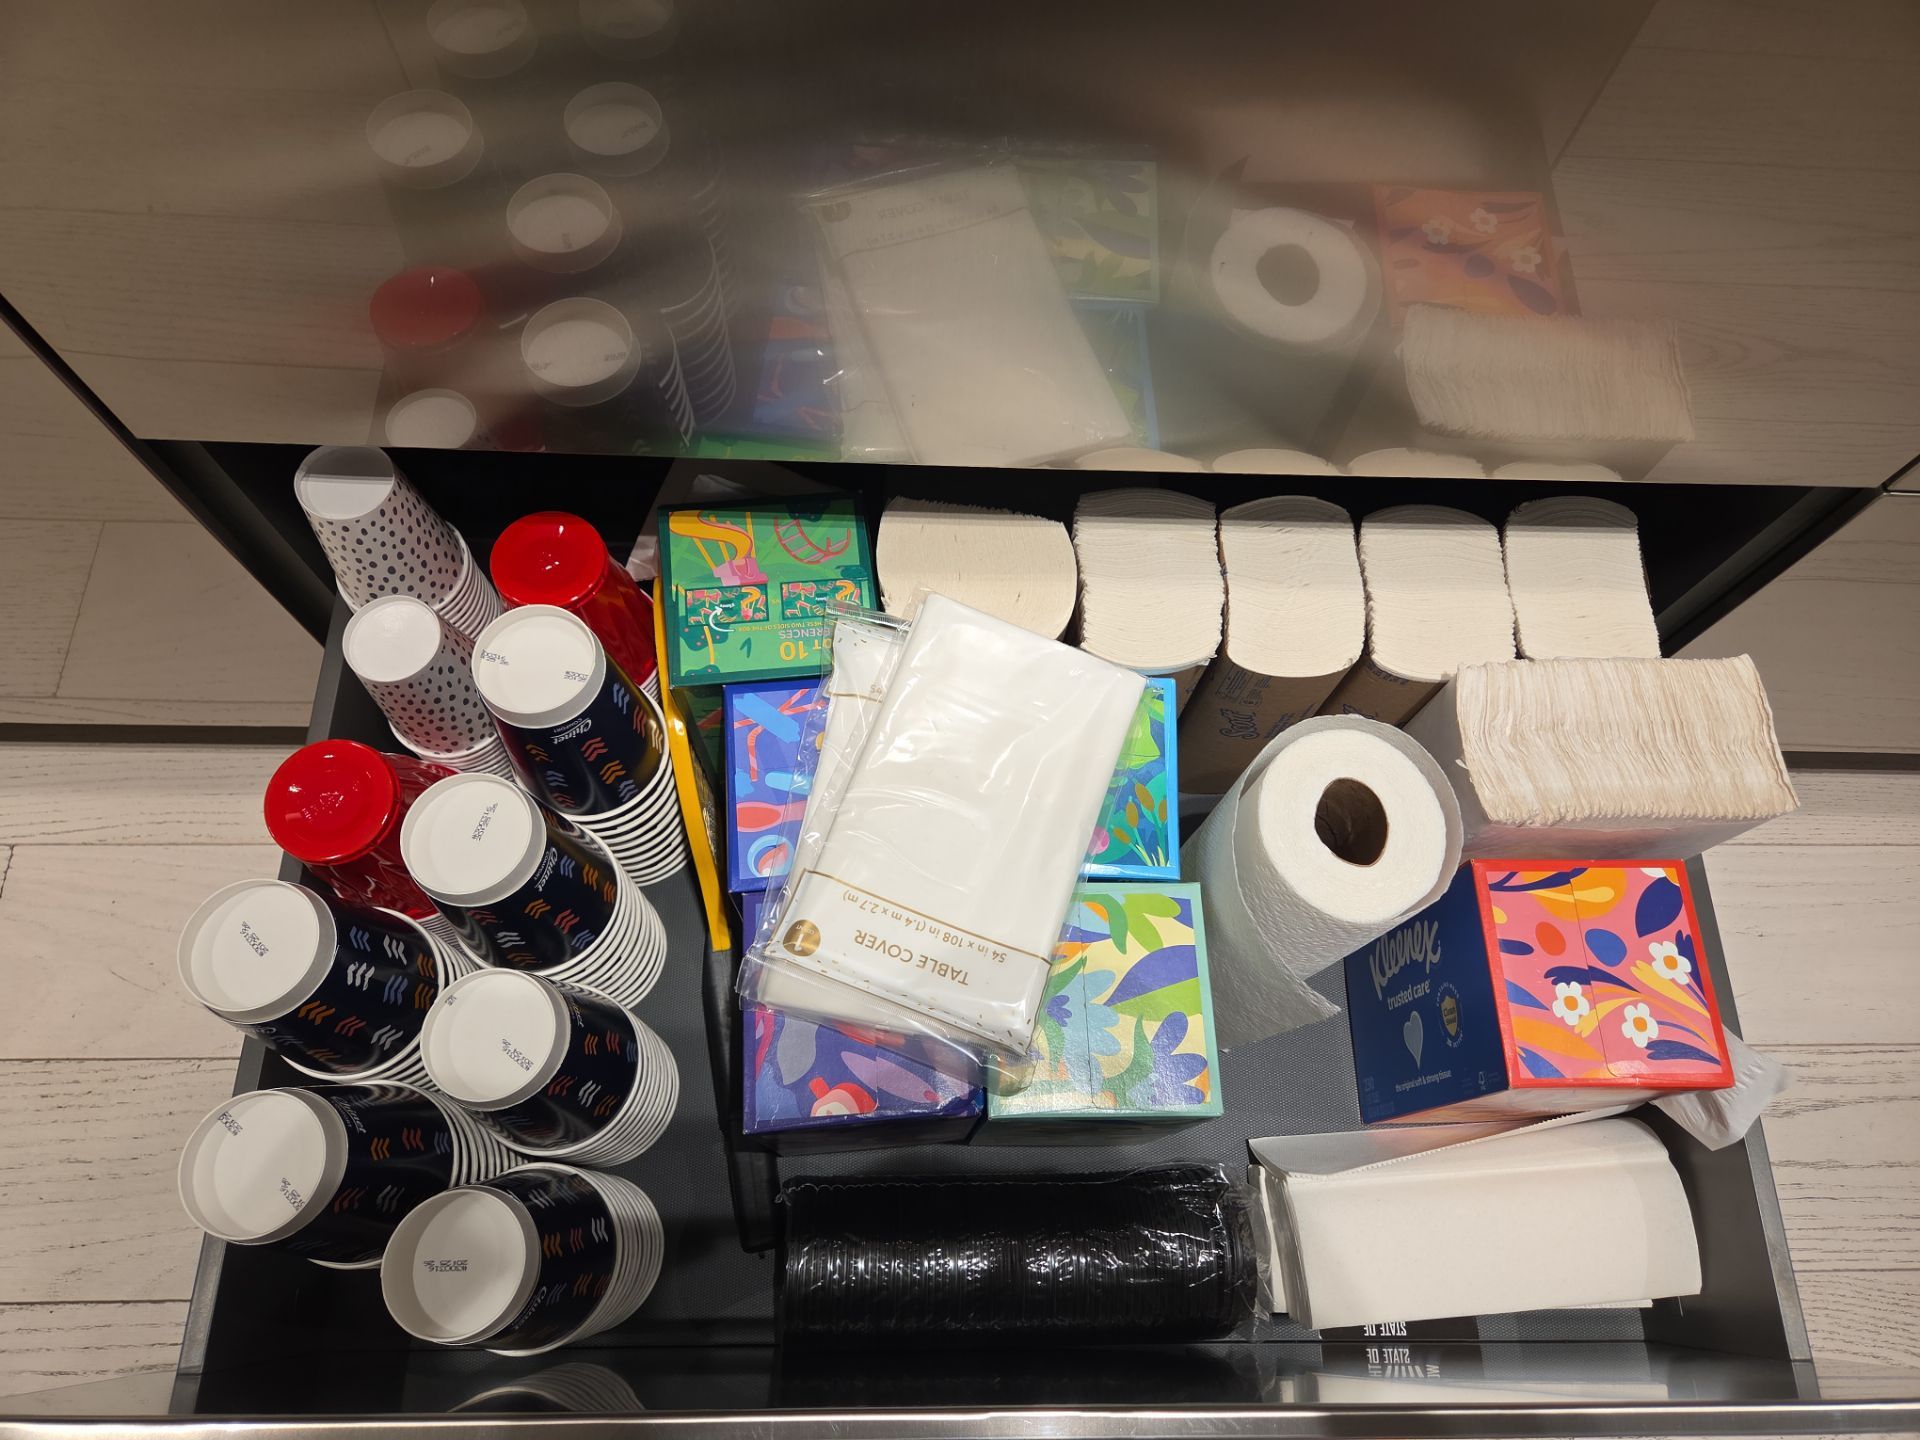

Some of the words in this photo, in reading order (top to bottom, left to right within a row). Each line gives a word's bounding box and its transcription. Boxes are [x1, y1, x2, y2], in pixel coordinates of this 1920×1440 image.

[777, 626, 832, 639] ERENCES
[778, 639, 808, 661] 10
[811, 637, 833, 650] OT
[550, 718, 593, 745] Chinet
[1219, 707, 1260, 740] Scott
[534, 846, 559, 892] Chinet
[840, 888, 860, 905] m)
[859, 897, 879, 915] 2.7
[879, 905, 889, 916] x
[889, 909, 902, 922] m
[902, 914, 927, 933] (1.4
[794, 922, 815, 935] CONT
[926, 925, 940, 941] in
[792, 932, 806, 952] 1
[852, 927, 915, 965] COVER
[941, 930, 964, 948] 108
[966, 940, 974, 949] x
[975, 943, 989, 958] in
[989, 948, 1007, 964] 54
[915, 952, 971, 986] TABLE
[1367, 919, 1442, 1001] Kleenex
[1387, 984, 1414, 1010] trusted
[1412, 979, 1431, 1002] care
[1380, 1321, 1407, 1336] STATE
